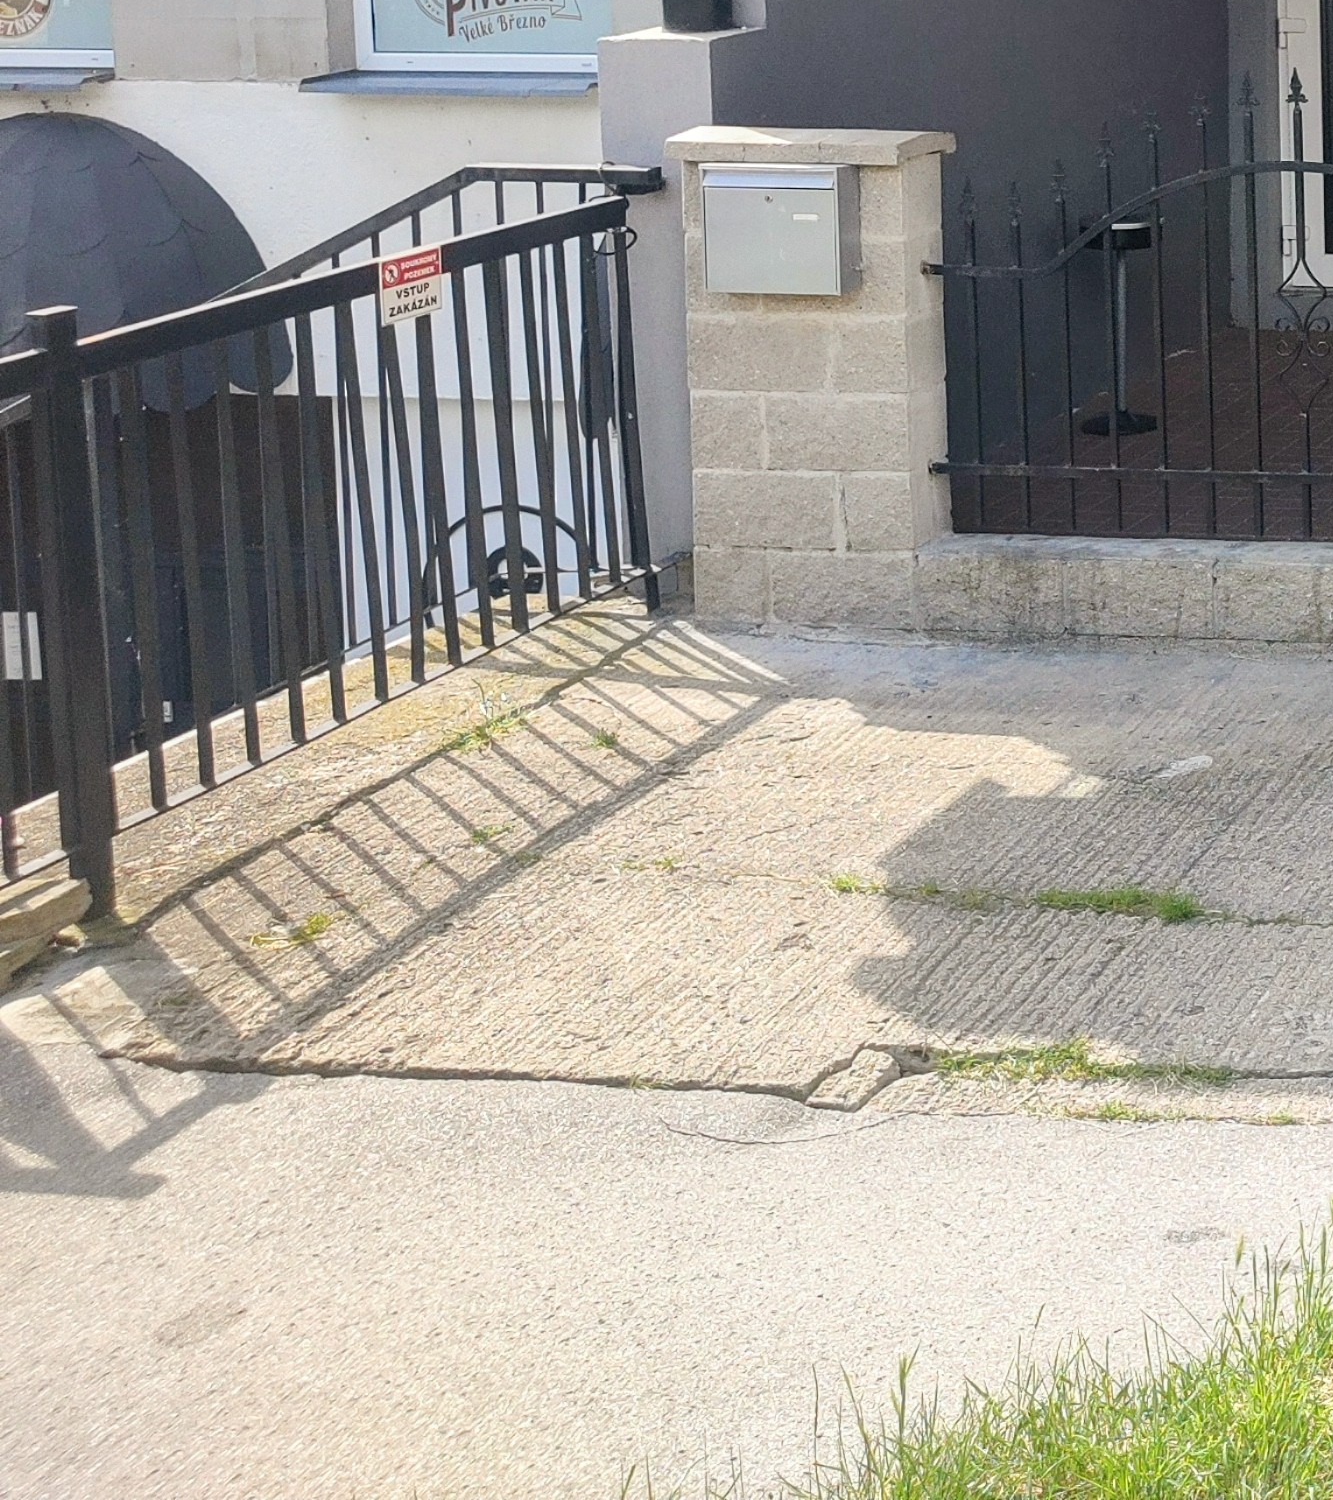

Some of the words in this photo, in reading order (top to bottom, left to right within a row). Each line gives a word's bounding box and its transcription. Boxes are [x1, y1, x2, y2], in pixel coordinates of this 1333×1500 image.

[458, 17, 495, 43] Velké
[496, 13, 547, 32] Březno
[396, 282, 430, 299] VSTUP
[388, 294, 438, 317] ZAKÁZÁN
